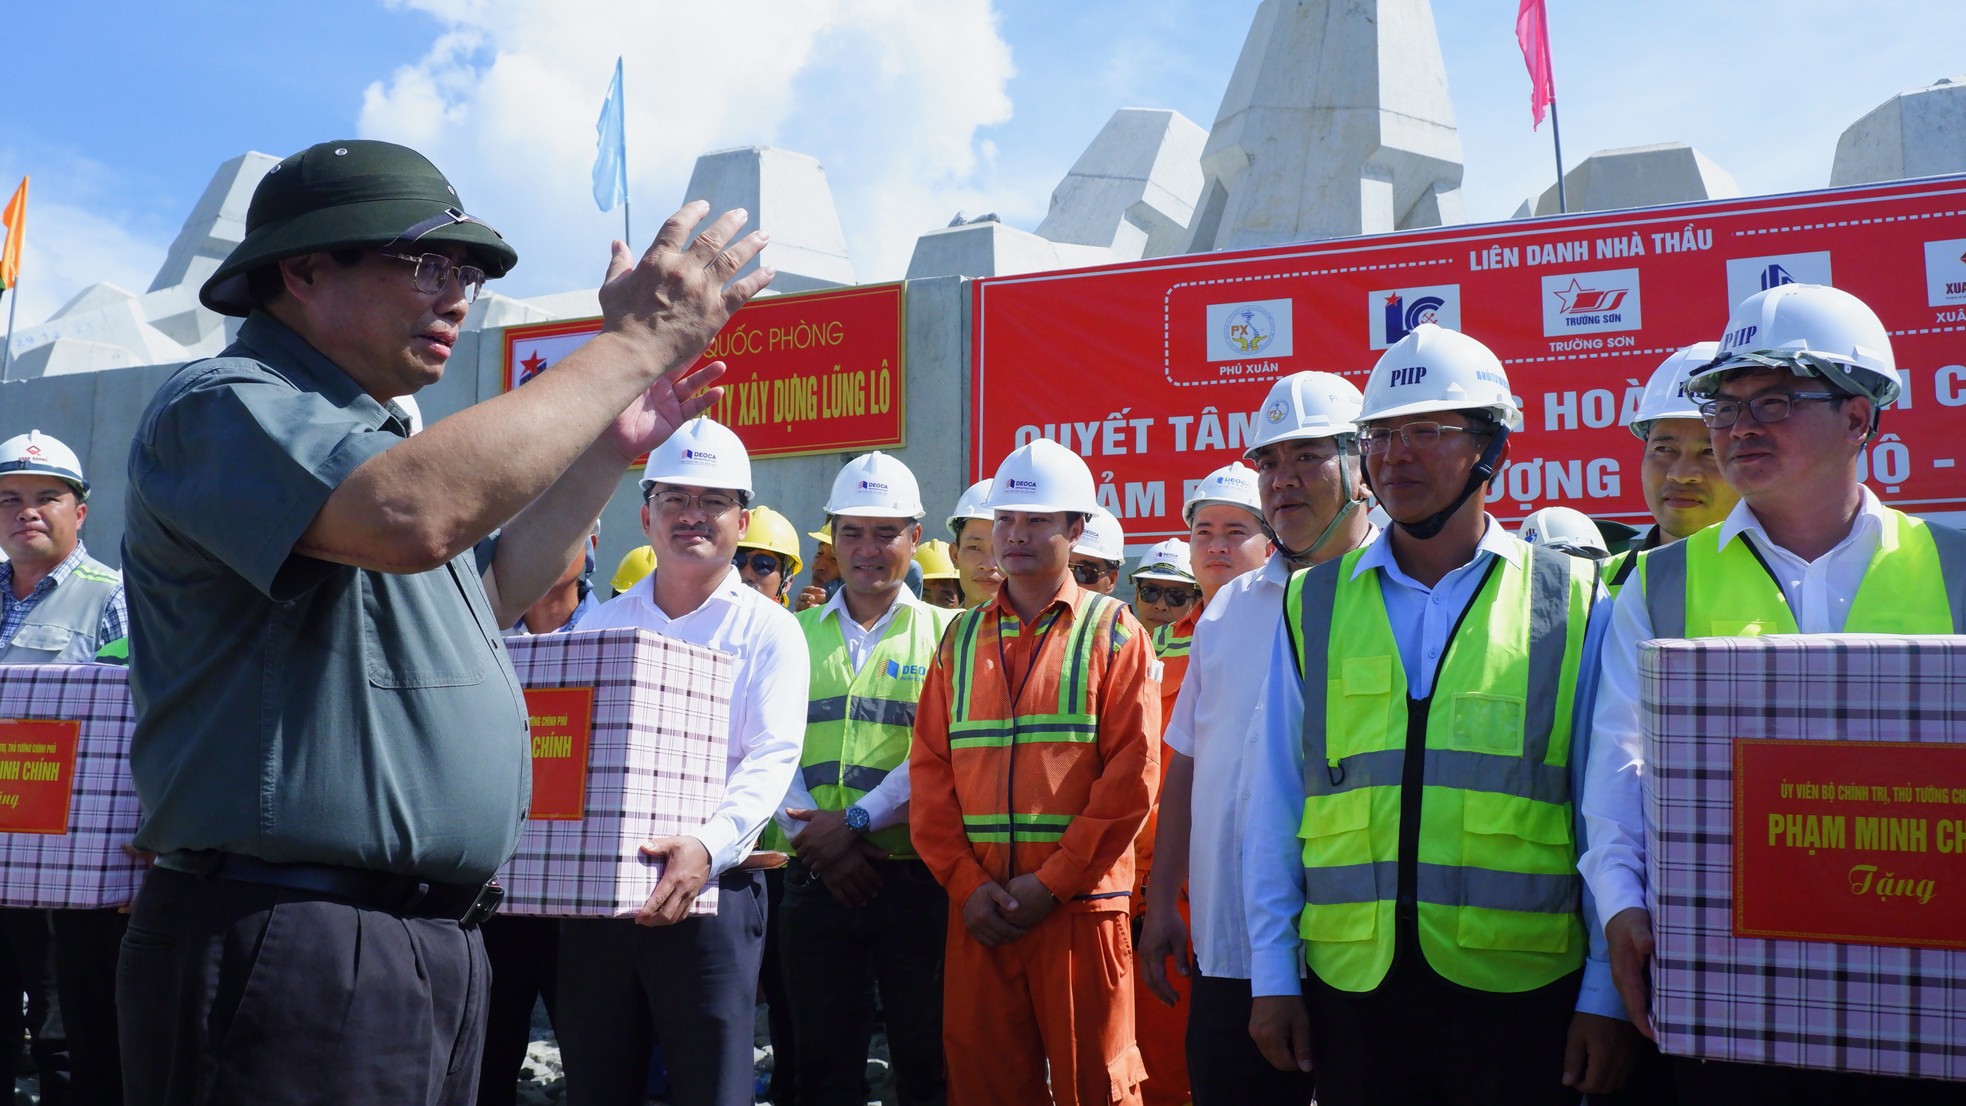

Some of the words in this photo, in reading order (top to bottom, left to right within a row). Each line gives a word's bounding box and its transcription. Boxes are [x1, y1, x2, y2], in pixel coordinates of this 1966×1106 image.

[1469, 245, 1520, 271] LIÊN
[1526, 240, 1589, 266] DANH
[1596, 231, 1646, 259] NHÀ
[1651, 223, 1713, 254] THẦU
[1231, 325, 1249, 336] PX
[1602, 313, 1622, 324] SƠN
[703, 323, 763, 358] QUỐC
[769, 319, 844, 352] PHÒNG
[1549, 337, 1603, 352] TRƯỜNG
[1607, 336, 1635, 348] SƠN
[1219, 362, 1242, 375] PHÚ
[1246, 360, 1279, 374] XUÂN
[738, 372, 769, 426] XÂY
[773, 374, 818, 432] DỰNG
[822, 365, 865, 420] LŨNG
[870, 359, 891, 416] LÔ
[694, 451, 717, 460] DEOCA
[1015, 480, 1037, 488] DEOCA
[532, 731, 572, 758] CHÍNH
[22, 757, 60, 781] CHÍNH
[1781, 778, 1794, 799] ỦY
[1796, 781, 1819, 799] VIÊN
[1822, 781, 1836, 803] BỘ
[1838, 782, 1869, 801] CHÍNH
[1893, 781, 1913, 802] THỦ
[1768, 813, 1846, 855] PHẠM
[1855, 816, 1927, 852] MINH
[1936, 819, 1966, 853] CH
[1848, 864, 1937, 904] Tặng
